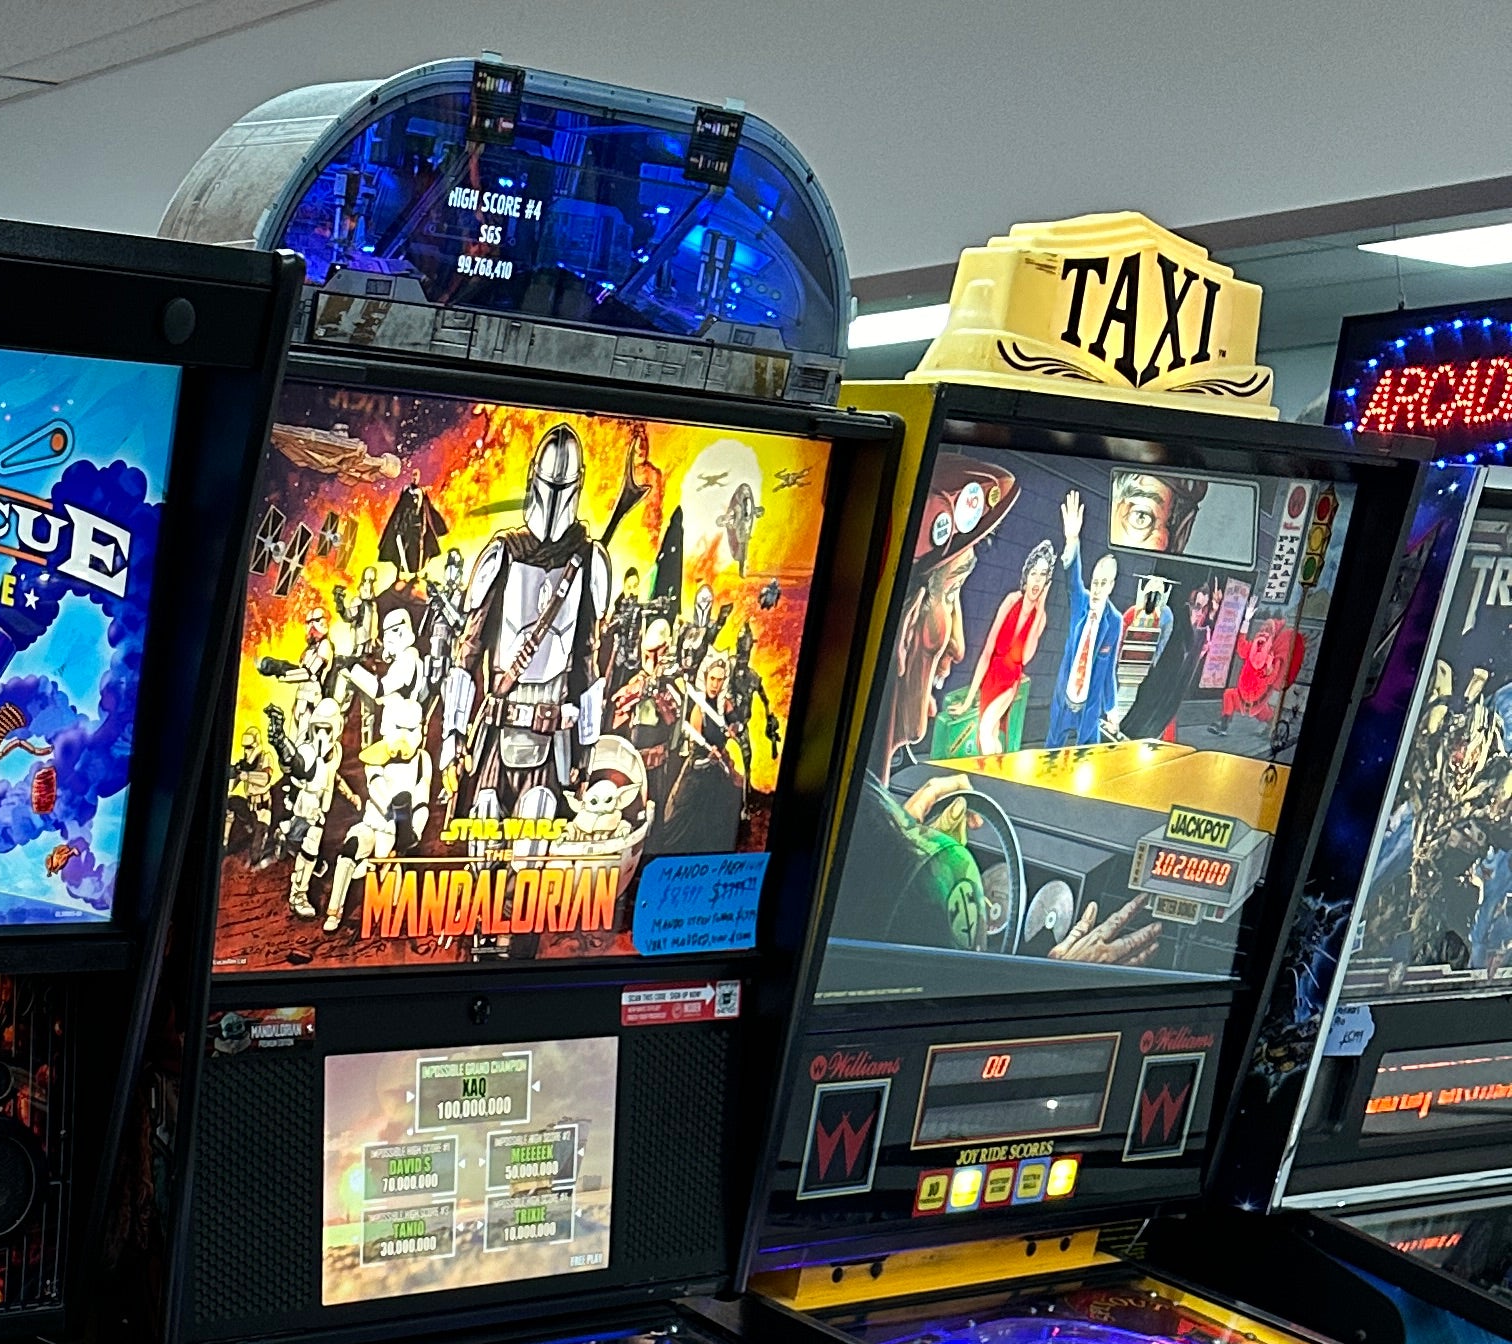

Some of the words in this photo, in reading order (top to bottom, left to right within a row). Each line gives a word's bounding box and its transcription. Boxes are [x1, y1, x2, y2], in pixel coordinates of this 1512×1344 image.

[448, 186, 478, 211] HIGH
[481, 190, 522, 218] SCORE
[525, 199, 544, 221] #4
[1061, 252, 1221, 389] TAXI
[1357, 357, 1512, 433] ARCAD
[440, 818, 500, 842] STAR
[500, 817, 568, 841] WARS
[1170, 813, 1231, 844] JACKPOT
[484, 849, 513, 863] THE
[361, 867, 620, 940] MANDALORIAN
[1152, 1026, 1216, 1051] Williams
[829, 1050, 901, 1078] Williams
[462, 1077, 487, 1098] XAQ
[389, 1158, 422, 1176] DAVID
[423, 1156, 433, 1173] S
[956, 1150, 979, 1166] JOY
[979, 1147, 1008, 1164] RIDE
[1008, 1140, 1055, 1160] SCORES
[570, 1255, 586, 1267] FREE
[586, 1253, 604, 1265] PLAY
